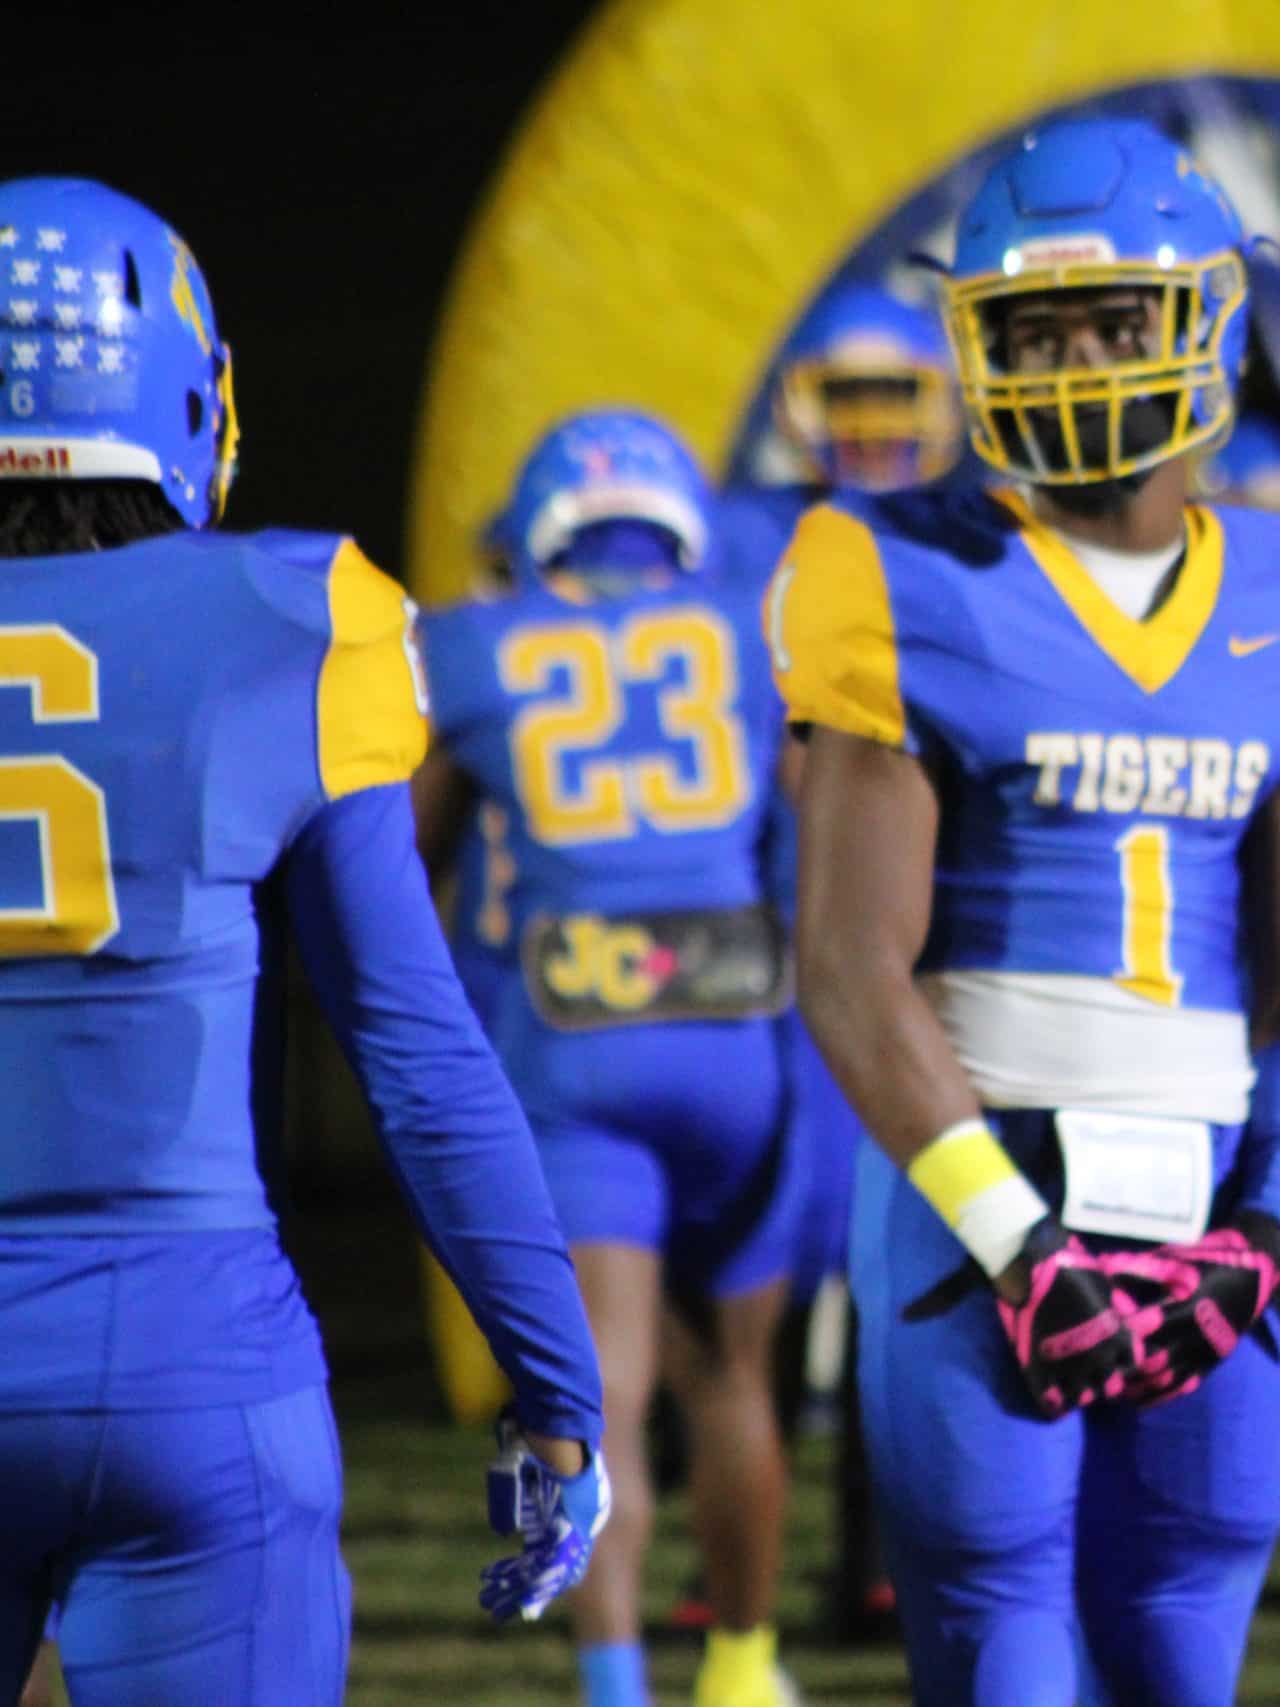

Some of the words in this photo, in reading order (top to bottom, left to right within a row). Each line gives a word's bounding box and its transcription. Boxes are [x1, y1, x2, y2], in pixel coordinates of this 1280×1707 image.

[496, 604, 755, 848] 23
[1025, 732, 1269, 820] TIGERS
[1112, 822, 1184, 1008] 1
